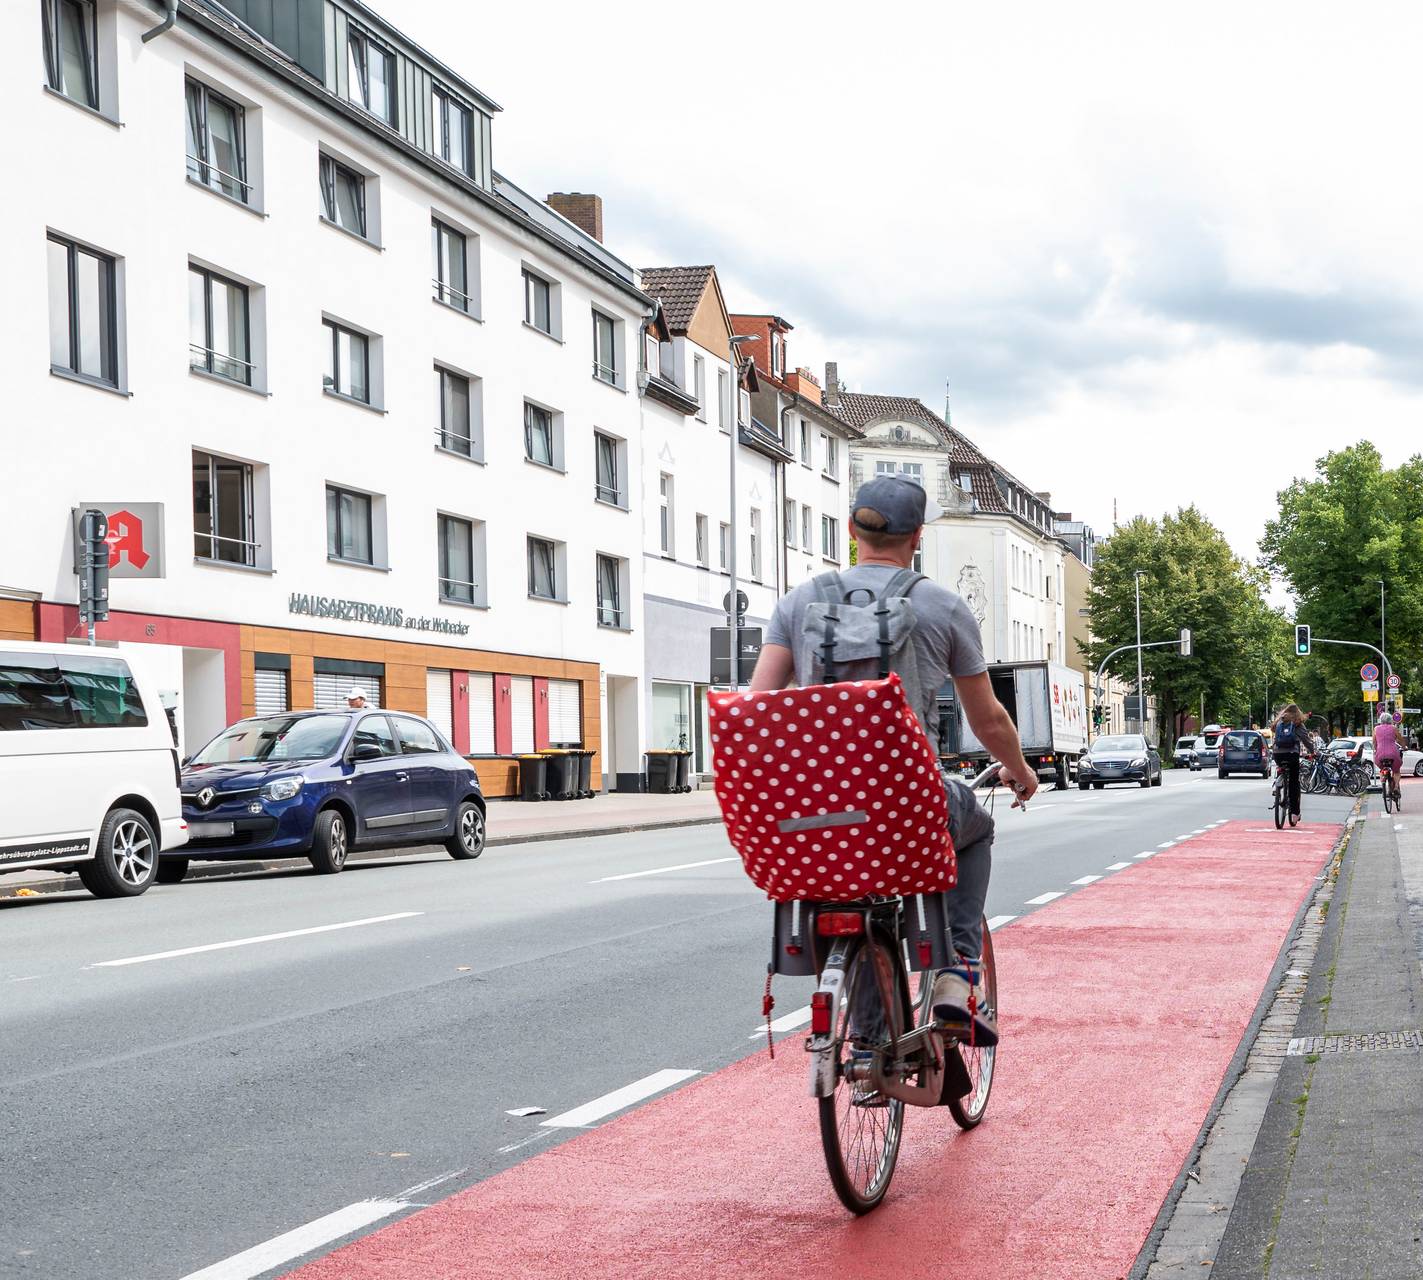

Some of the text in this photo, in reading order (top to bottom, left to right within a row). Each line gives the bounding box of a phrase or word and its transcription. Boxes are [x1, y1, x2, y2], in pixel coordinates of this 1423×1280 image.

[288, 592, 470, 636] HAUSARZTPRAXIS an der Wolbecker
